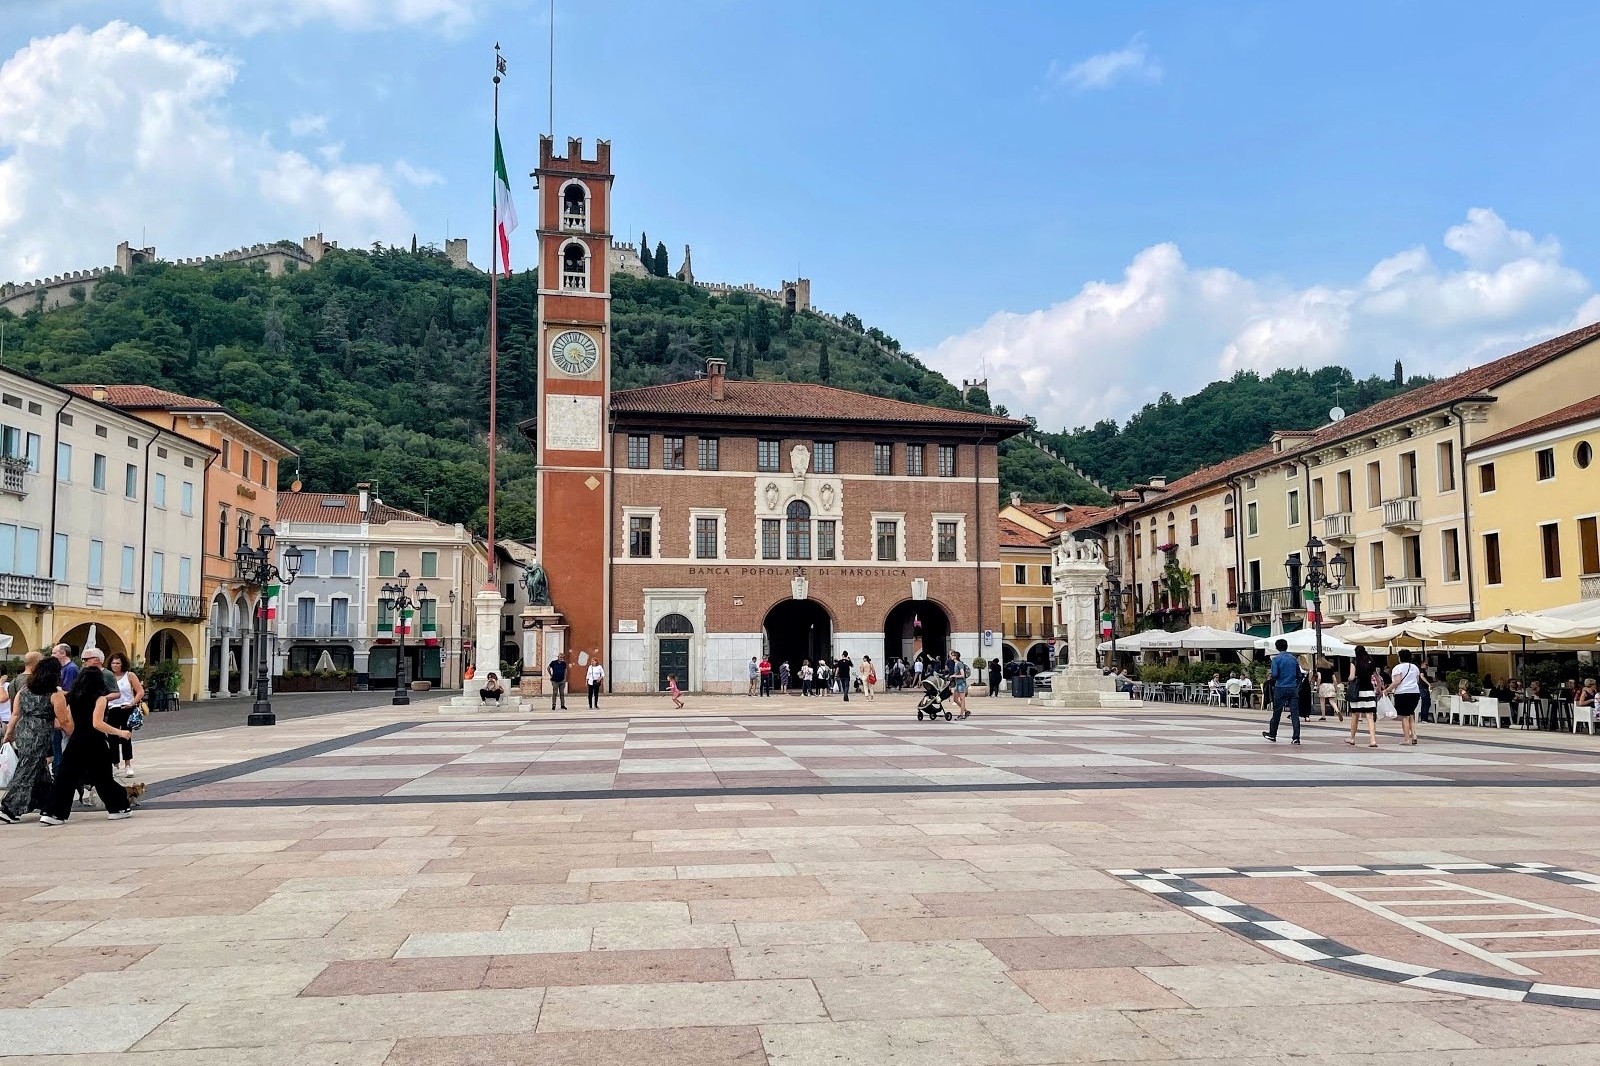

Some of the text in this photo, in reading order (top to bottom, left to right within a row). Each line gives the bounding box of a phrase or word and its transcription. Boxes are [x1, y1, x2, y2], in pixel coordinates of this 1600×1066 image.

[689, 567, 907, 577] BANCA POPOLARE DI MAROSTICA
